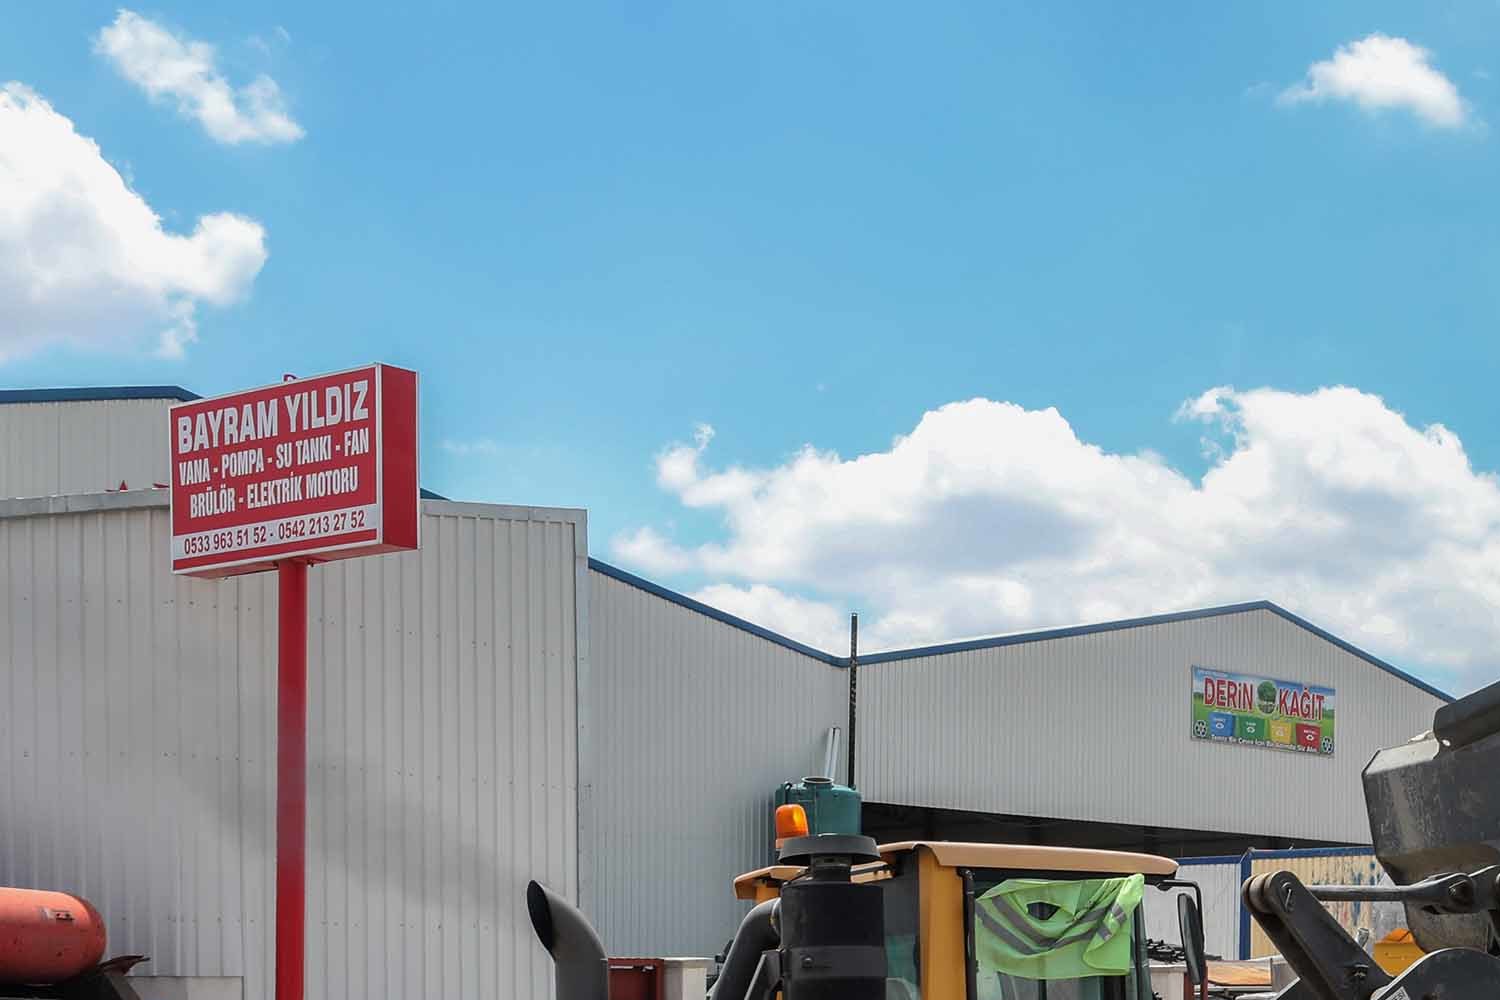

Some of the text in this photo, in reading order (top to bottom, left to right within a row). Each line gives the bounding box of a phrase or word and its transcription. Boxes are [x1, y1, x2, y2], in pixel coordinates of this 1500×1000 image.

[178, 380, 368, 454] BAYRAM YILDIZ
[179, 458, 211, 486] VANA
[222, 448, 264, 479] POMPA
[276, 442, 292, 469] SU
[296, 435, 331, 465] TANKI
[344, 427, 368, 456] FAN
[190, 484, 235, 519] BRÜLÖR
[247, 471, 302, 509] ELEKTRİK
[306, 466, 358, 499] MOTORU
[184, 535, 210, 554] 0533
[213, 531, 233, 550] 963
[237, 528, 248, 546] 51
[254, 526, 266, 544] 52
[278, 520, 305, 539] 0542
[309, 516, 329, 535] 213
[334, 513, 346, 531] 27
[351, 510, 364, 528] 52
[1279, 688, 1325, 720] KAĞIT
